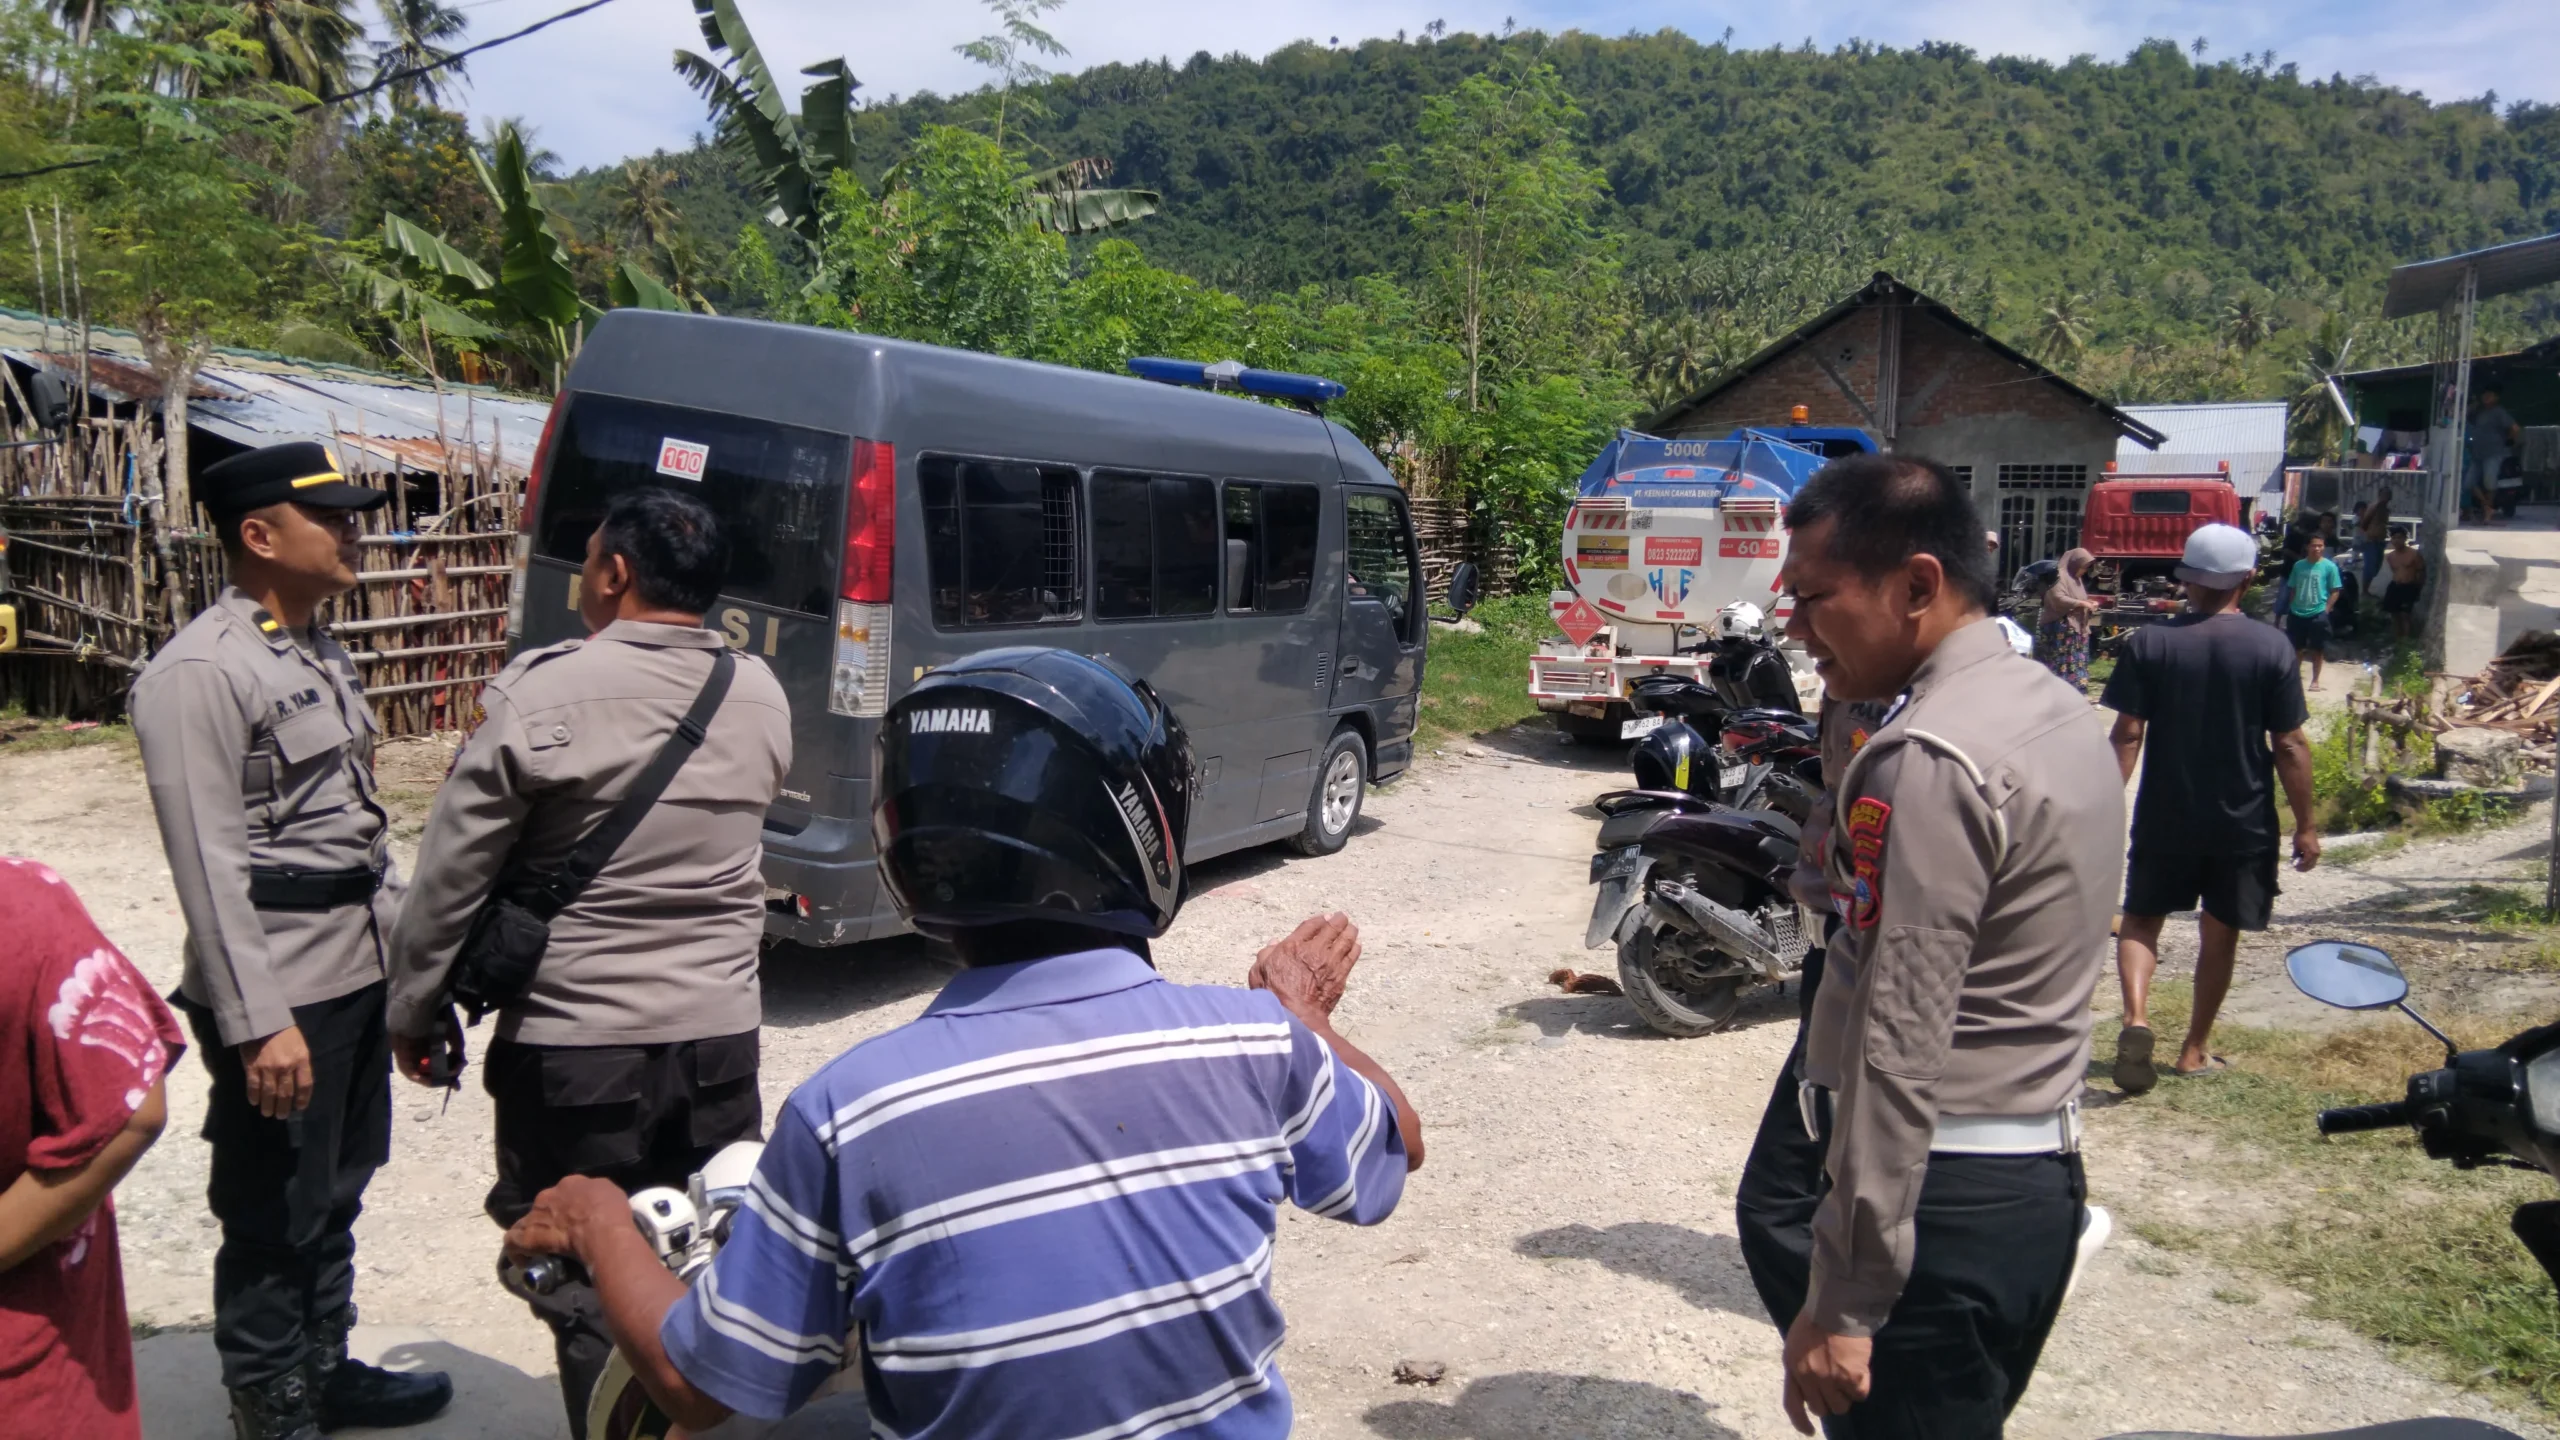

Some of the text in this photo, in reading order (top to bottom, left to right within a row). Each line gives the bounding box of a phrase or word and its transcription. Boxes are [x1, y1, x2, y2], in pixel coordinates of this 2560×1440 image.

[665, 449, 702, 472] 110
[1671, 489, 1696, 498] CAHAYA
[1647, 548, 1664, 560] 0823
[1738, 541, 1760, 555] 60
[910, 709, 992, 735] YAMAHA
[780, 788, 811, 803] armada
[1118, 781, 1160, 858] YAMAHA
